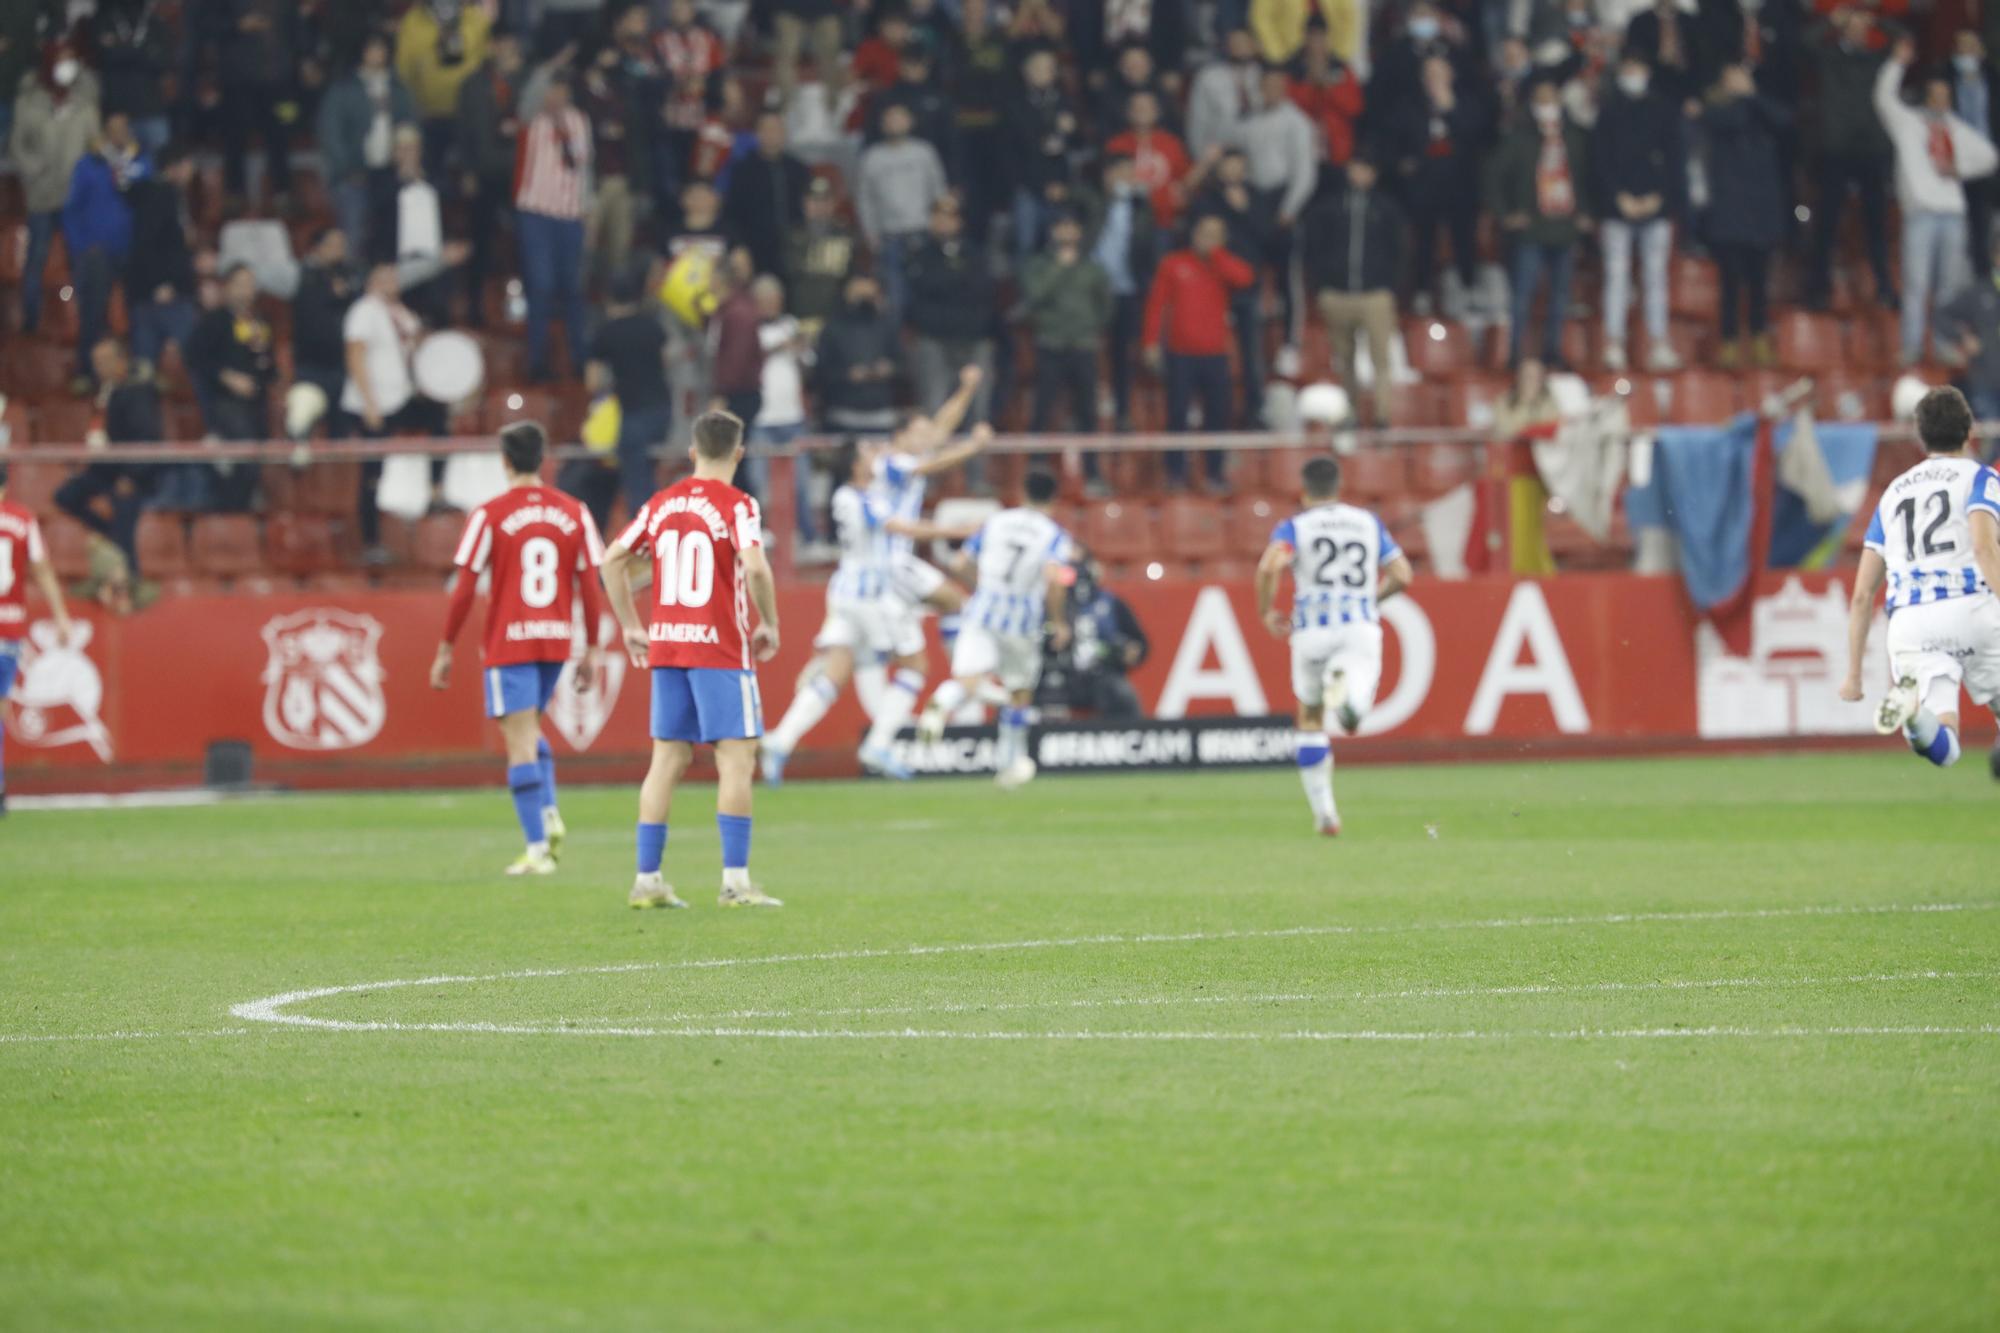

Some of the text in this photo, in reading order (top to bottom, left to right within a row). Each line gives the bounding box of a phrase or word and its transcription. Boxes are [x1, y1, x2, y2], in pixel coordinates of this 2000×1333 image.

[1895, 489, 1956, 562] 12
[520, 537, 559, 608] 8
[656, 529, 716, 609] 10
[1005, 541, 1029, 585] 7
[1312, 536, 1368, 588] 23
